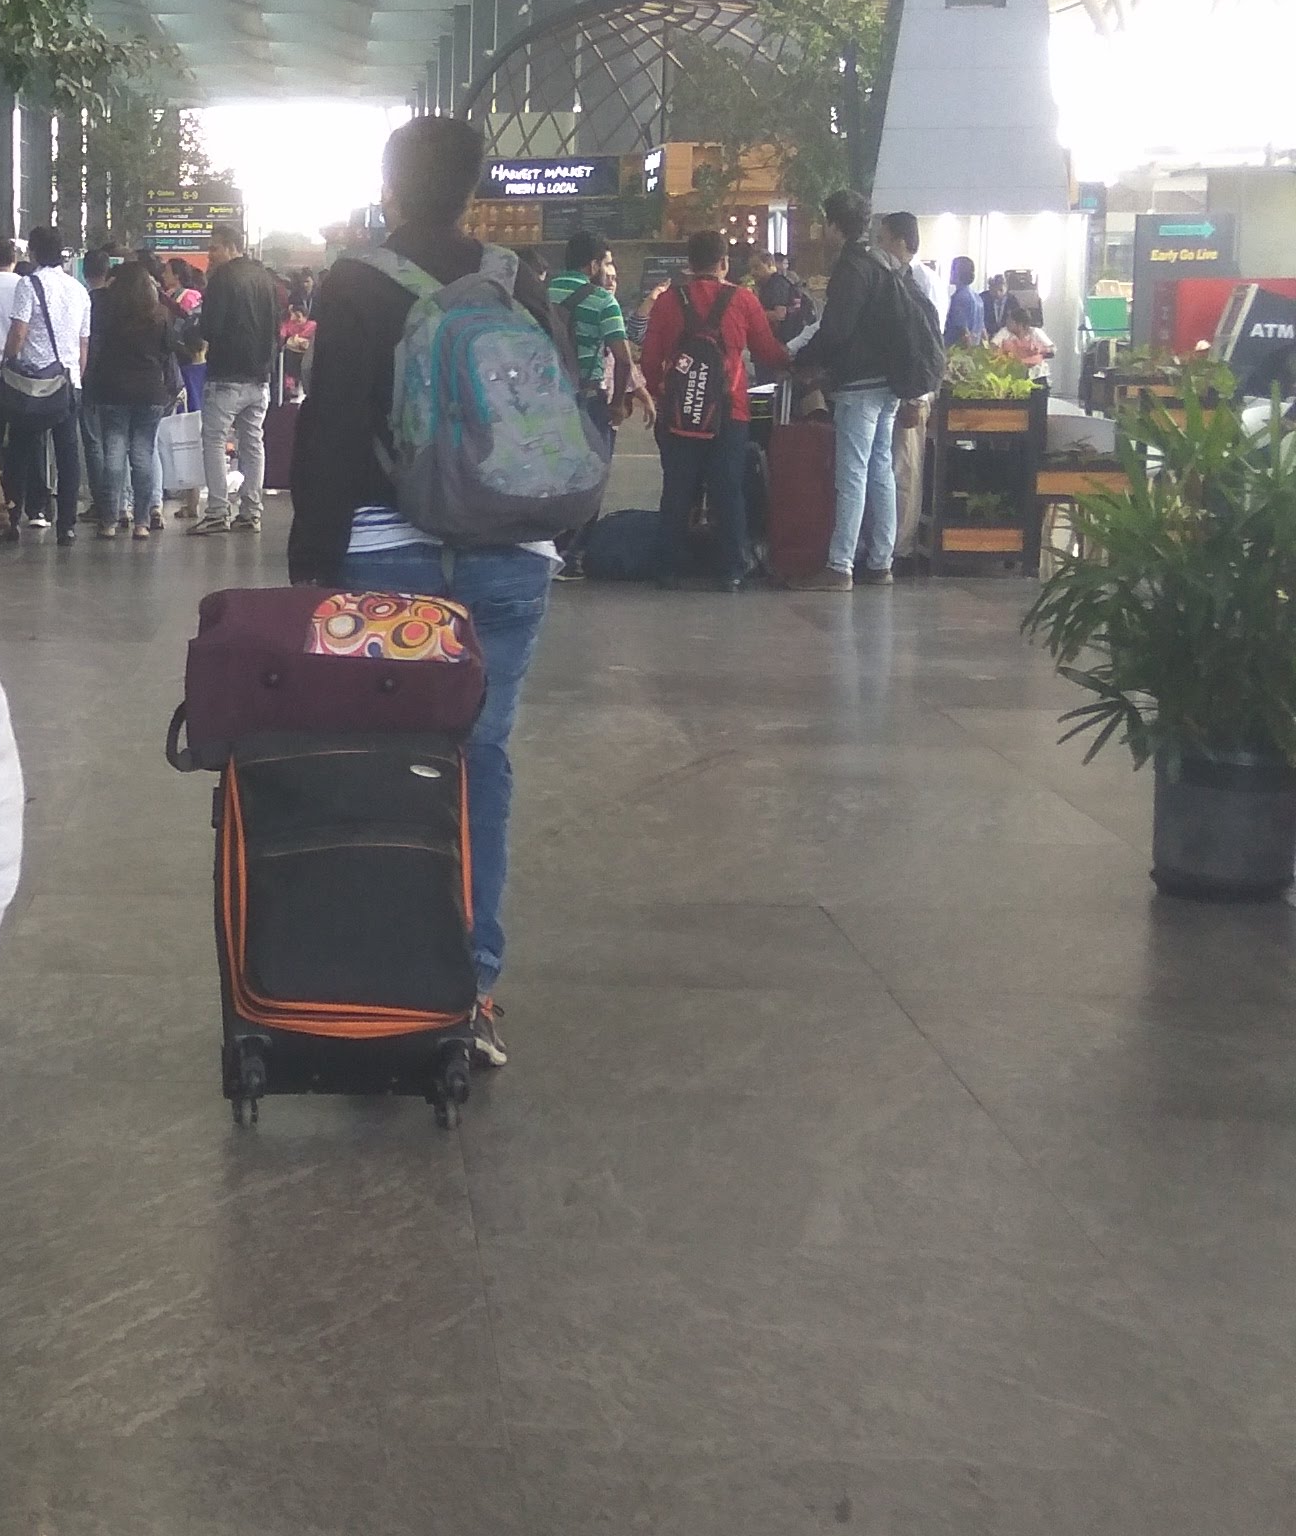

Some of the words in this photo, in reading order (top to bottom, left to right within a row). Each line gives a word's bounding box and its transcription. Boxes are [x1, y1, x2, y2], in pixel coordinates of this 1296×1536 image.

[536, 181, 547, 195] &
[547, 181, 579, 194] LOCAL
[155, 222, 168, 230] City
[168, 222, 181, 230] bus
[1250, 323, 1295, 339] ATM
[692, 362, 709, 424] MILITARY
